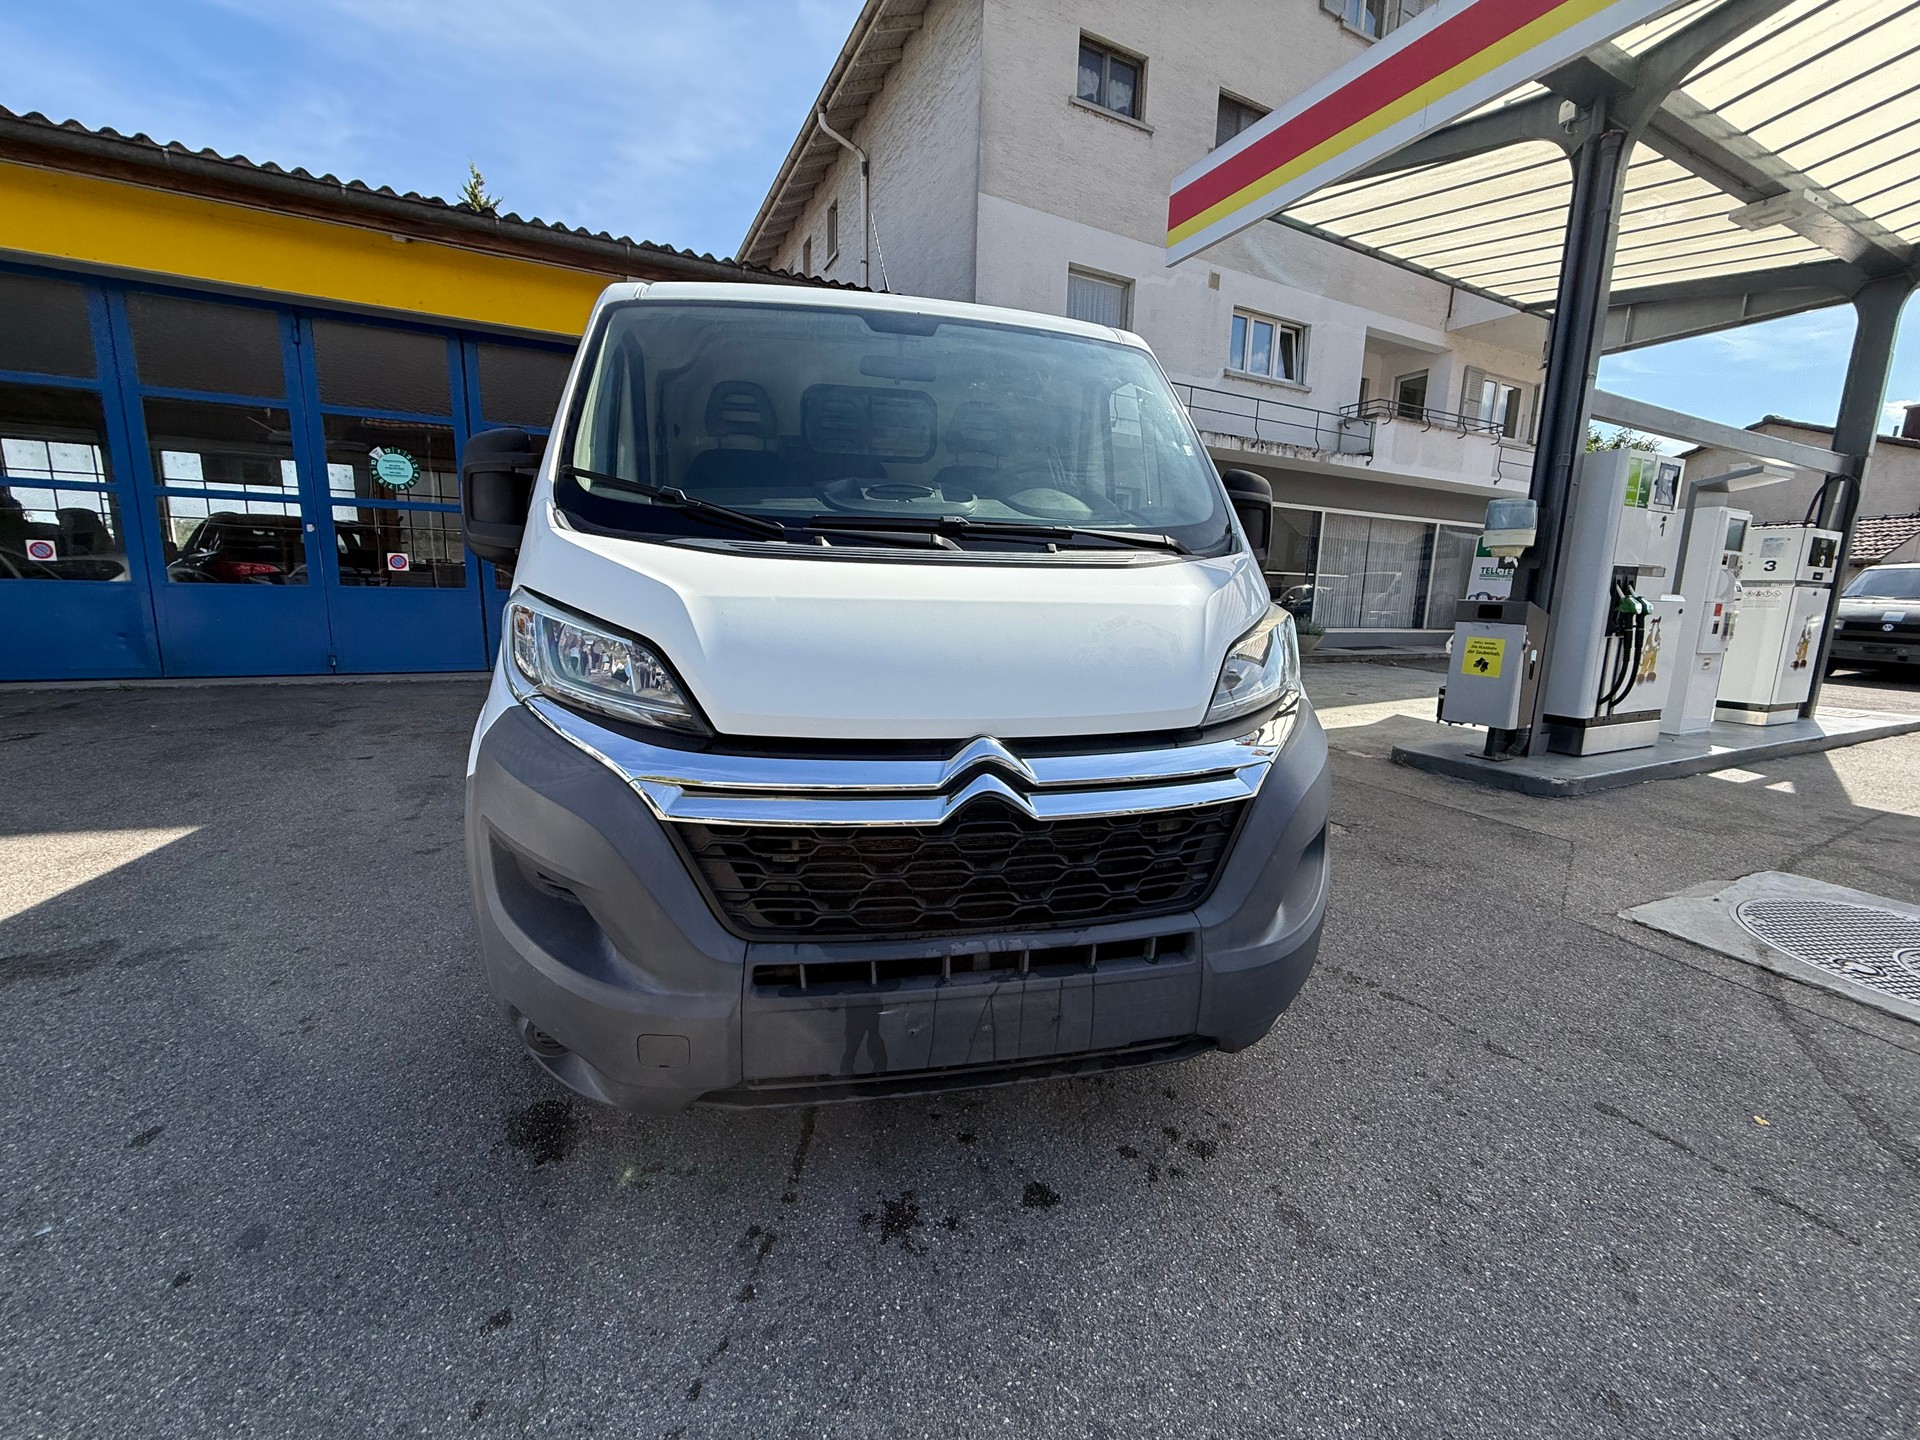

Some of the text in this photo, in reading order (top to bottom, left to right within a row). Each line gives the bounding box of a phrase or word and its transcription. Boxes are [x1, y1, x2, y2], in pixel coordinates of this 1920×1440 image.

[1659, 522, 1665, 537] 1
[1763, 560, 1777, 572] 3
[1819, 555, 1826, 568] 3
